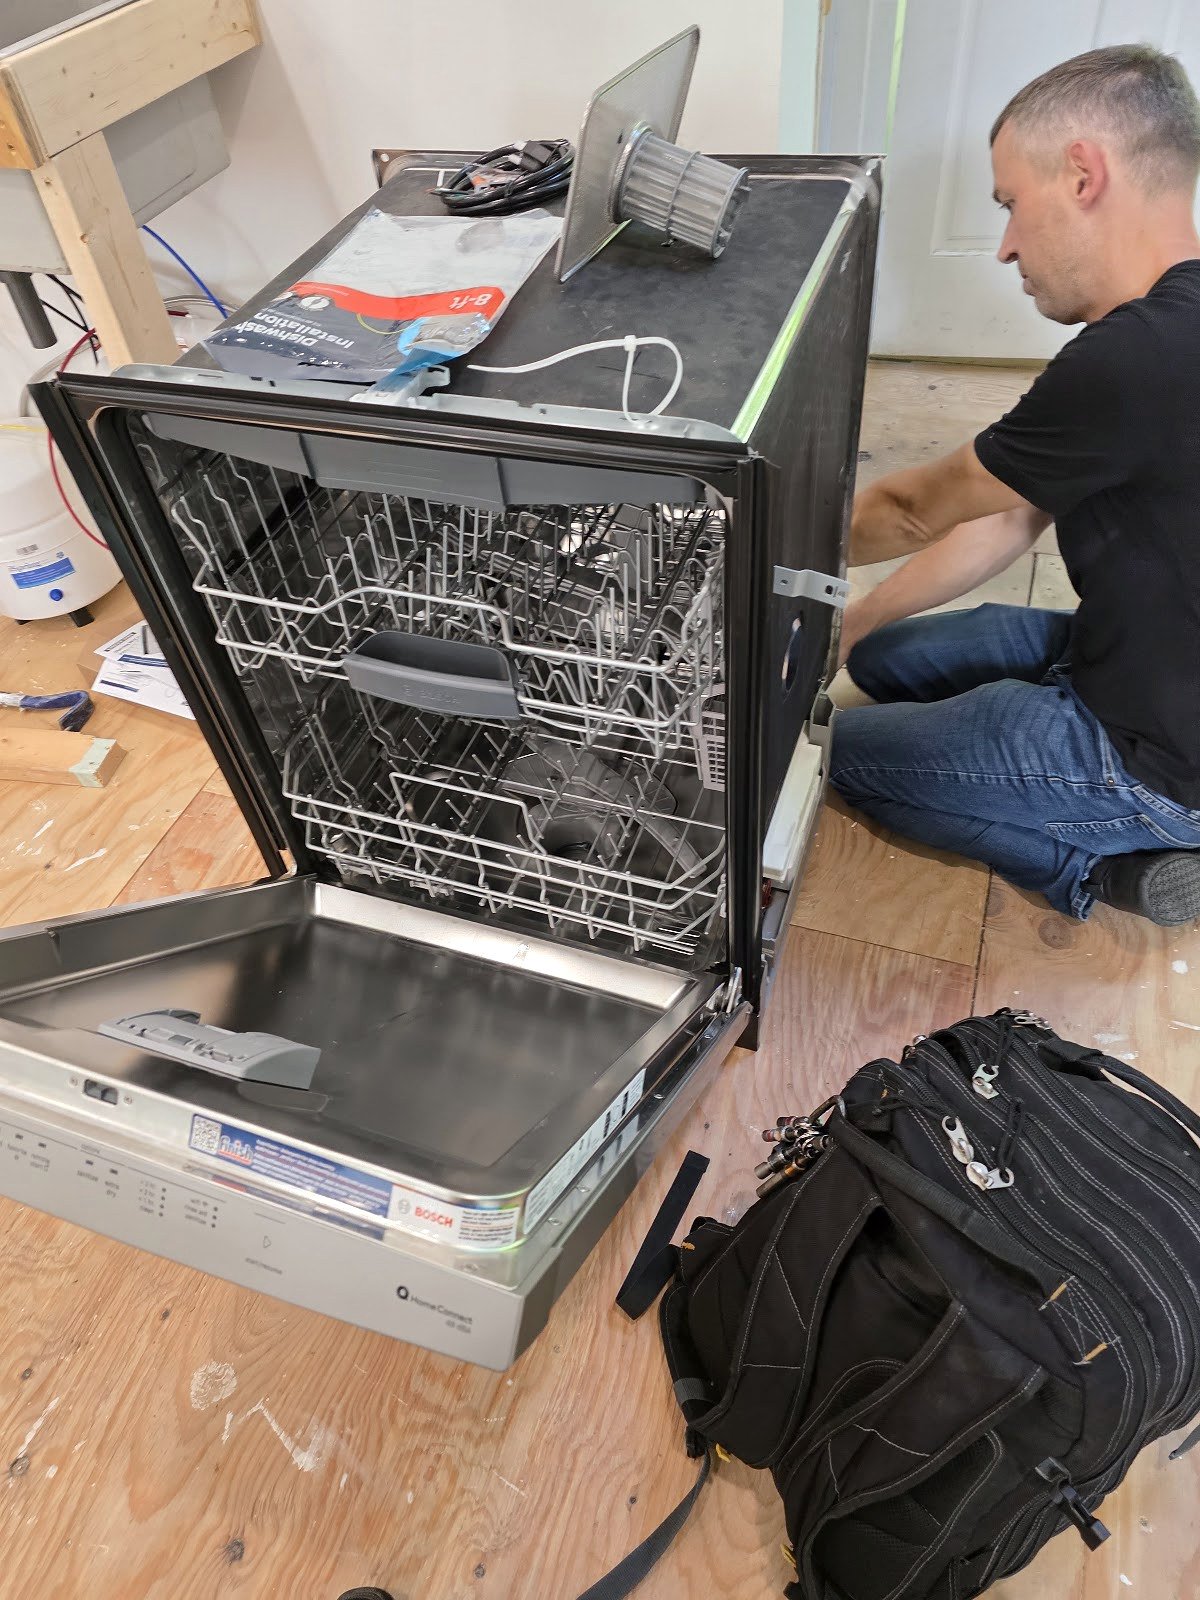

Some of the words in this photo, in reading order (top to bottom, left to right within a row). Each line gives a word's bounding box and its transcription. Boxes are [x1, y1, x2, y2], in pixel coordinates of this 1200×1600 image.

[449, 293, 493, 310] 8-ft
[220, 1134, 254, 1162] finish
[414, 1206, 454, 1229] BOSCH
